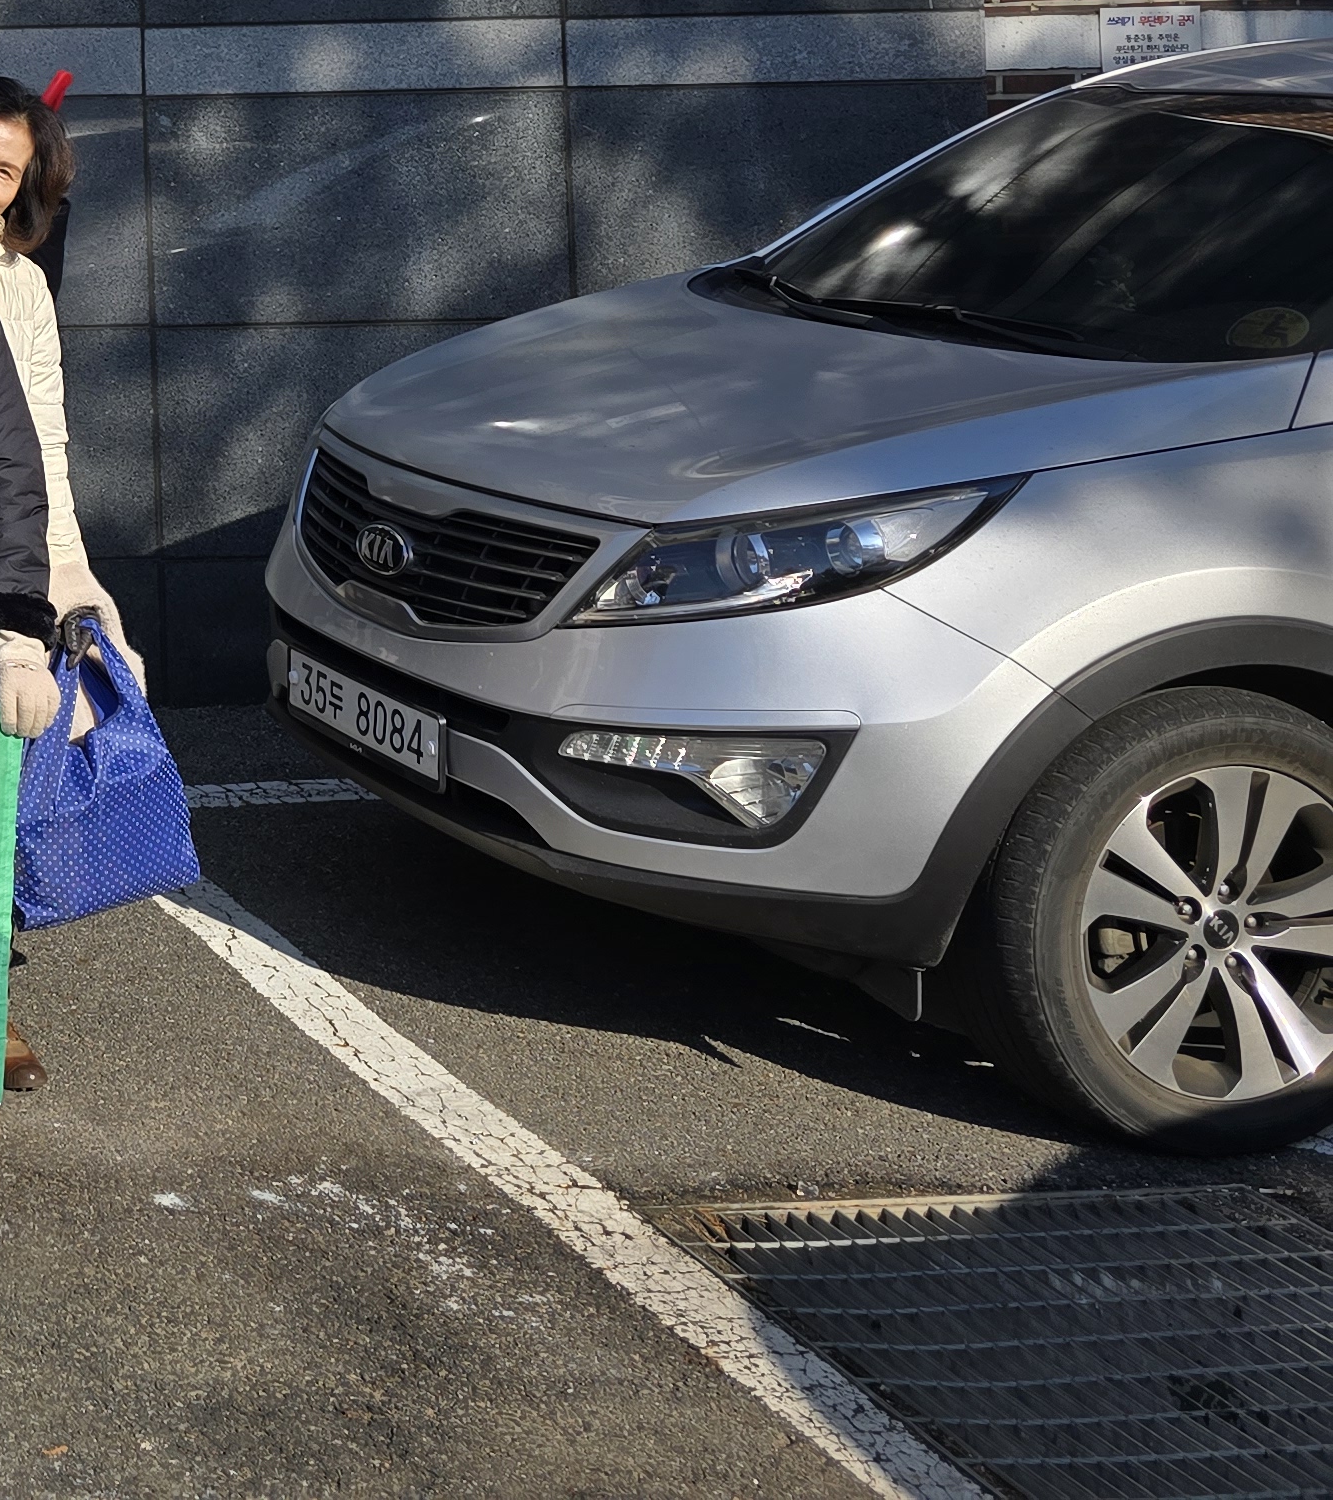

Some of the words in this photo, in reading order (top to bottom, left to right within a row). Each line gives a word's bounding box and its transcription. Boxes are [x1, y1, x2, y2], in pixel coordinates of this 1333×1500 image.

[1106, 15, 1135, 27] 쓰레기
[1138, 14, 1174, 28] 무단투기
[1176, 14, 1195, 27] 금지
[1125, 33, 1153, 43] 동춘3동
[1157, 32, 1180, 42] 주민은
[1116, 44, 1144, 54] 무단투기
[360, 529, 395, 569] KIA
[299, 662, 344, 721] 35두
[355, 691, 424, 766] 8084
[1208, 914, 1235, 945] KIA
